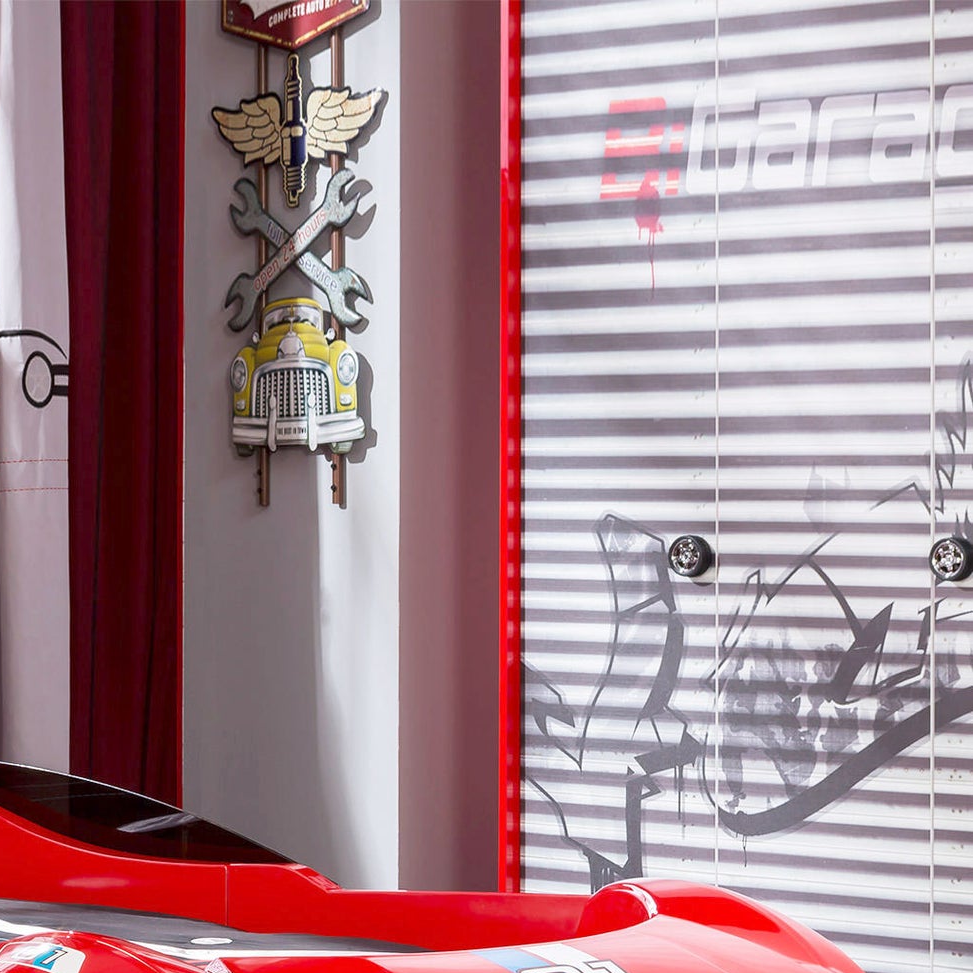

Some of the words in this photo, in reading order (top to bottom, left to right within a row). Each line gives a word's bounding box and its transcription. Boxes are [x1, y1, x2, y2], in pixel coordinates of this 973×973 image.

[268, 4, 305, 28] COMPLETE
[253, 259, 280, 292] open
[281, 240, 296, 263] 24
[296, 208, 327, 244] hours
[267, 220, 284, 246] full
[298, 252, 338, 292] service
